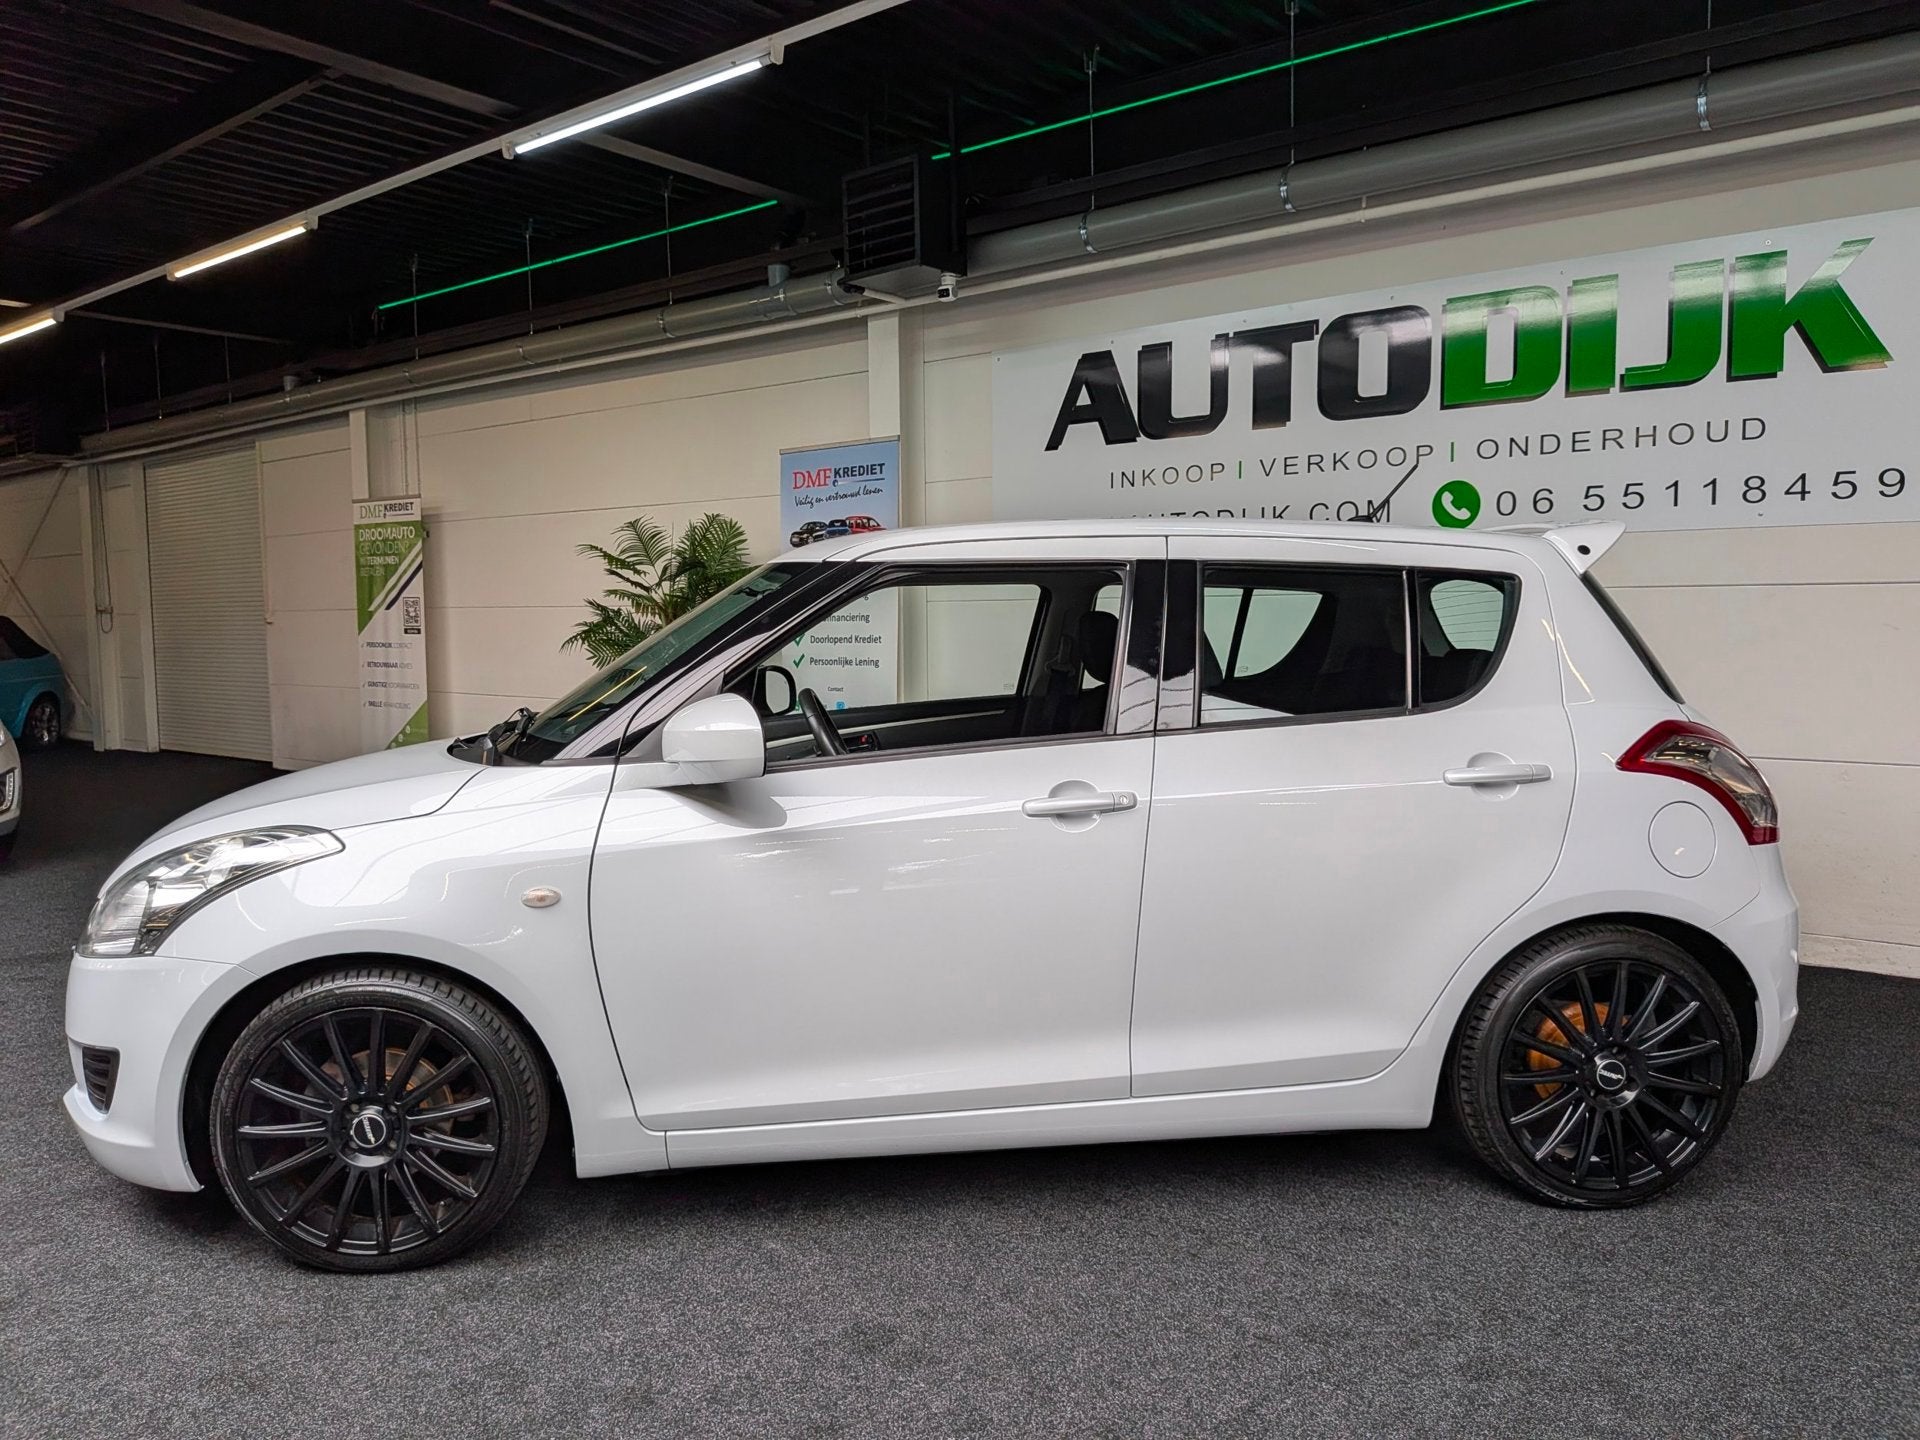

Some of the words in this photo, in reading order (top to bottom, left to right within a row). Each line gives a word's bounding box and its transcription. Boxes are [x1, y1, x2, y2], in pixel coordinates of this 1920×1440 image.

[1044, 237, 1893, 451] AUTODIJK
[1110, 462, 1225, 489] INKOOP
[1259, 444, 1434, 477] VERKOOP
[1476, 416, 1768, 460] ONDERHOUD
[793, 468, 832, 489] DMF
[833, 463, 885, 479] KREDIET
[795, 494, 814, 508] Veilig
[825, 487, 861, 502] vertrouwd
[862, 484, 884, 495] lenen
[1496, 488, 1555, 517] 06
[360, 505, 383, 519] DMF
[383, 502, 414, 512] KREDIET
[359, 526, 416, 541] DROOMAUTO
[810, 634, 853, 646] Doorlopend
[854, 635, 882, 644] Krediet
[809, 656, 853, 668] Persoonlijke
[855, 657, 880, 669] Lening
